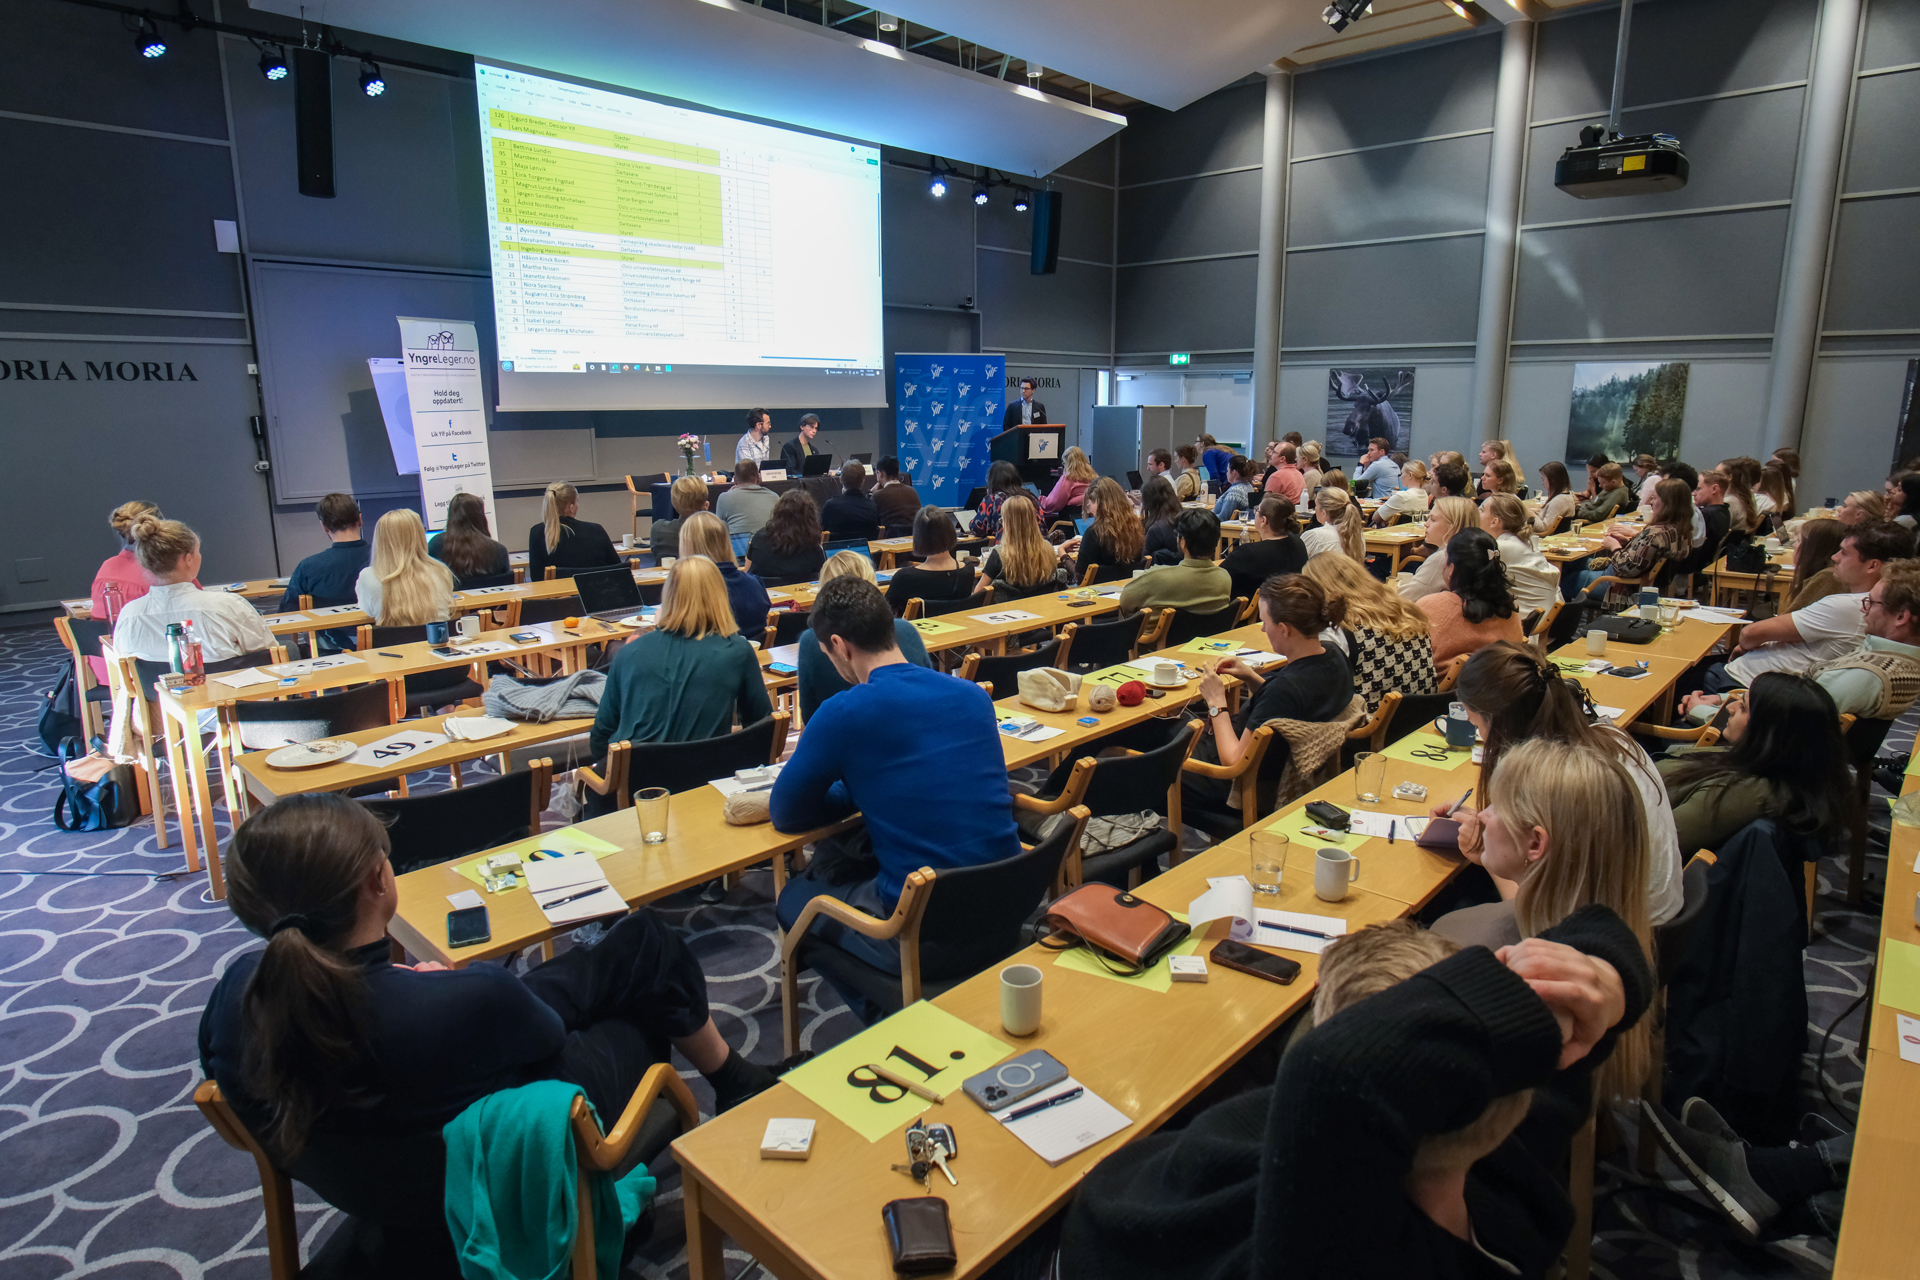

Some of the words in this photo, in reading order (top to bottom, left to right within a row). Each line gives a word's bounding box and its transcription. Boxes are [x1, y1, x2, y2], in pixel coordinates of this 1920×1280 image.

[408, 352, 476, 366] YngreLeger.no
[83, 360, 199, 382] MORIA
[1037, 377, 1061, 388] ORIA
[372, 740, 433, 759] 49.
[846, 1044, 966, 1104] 81.
